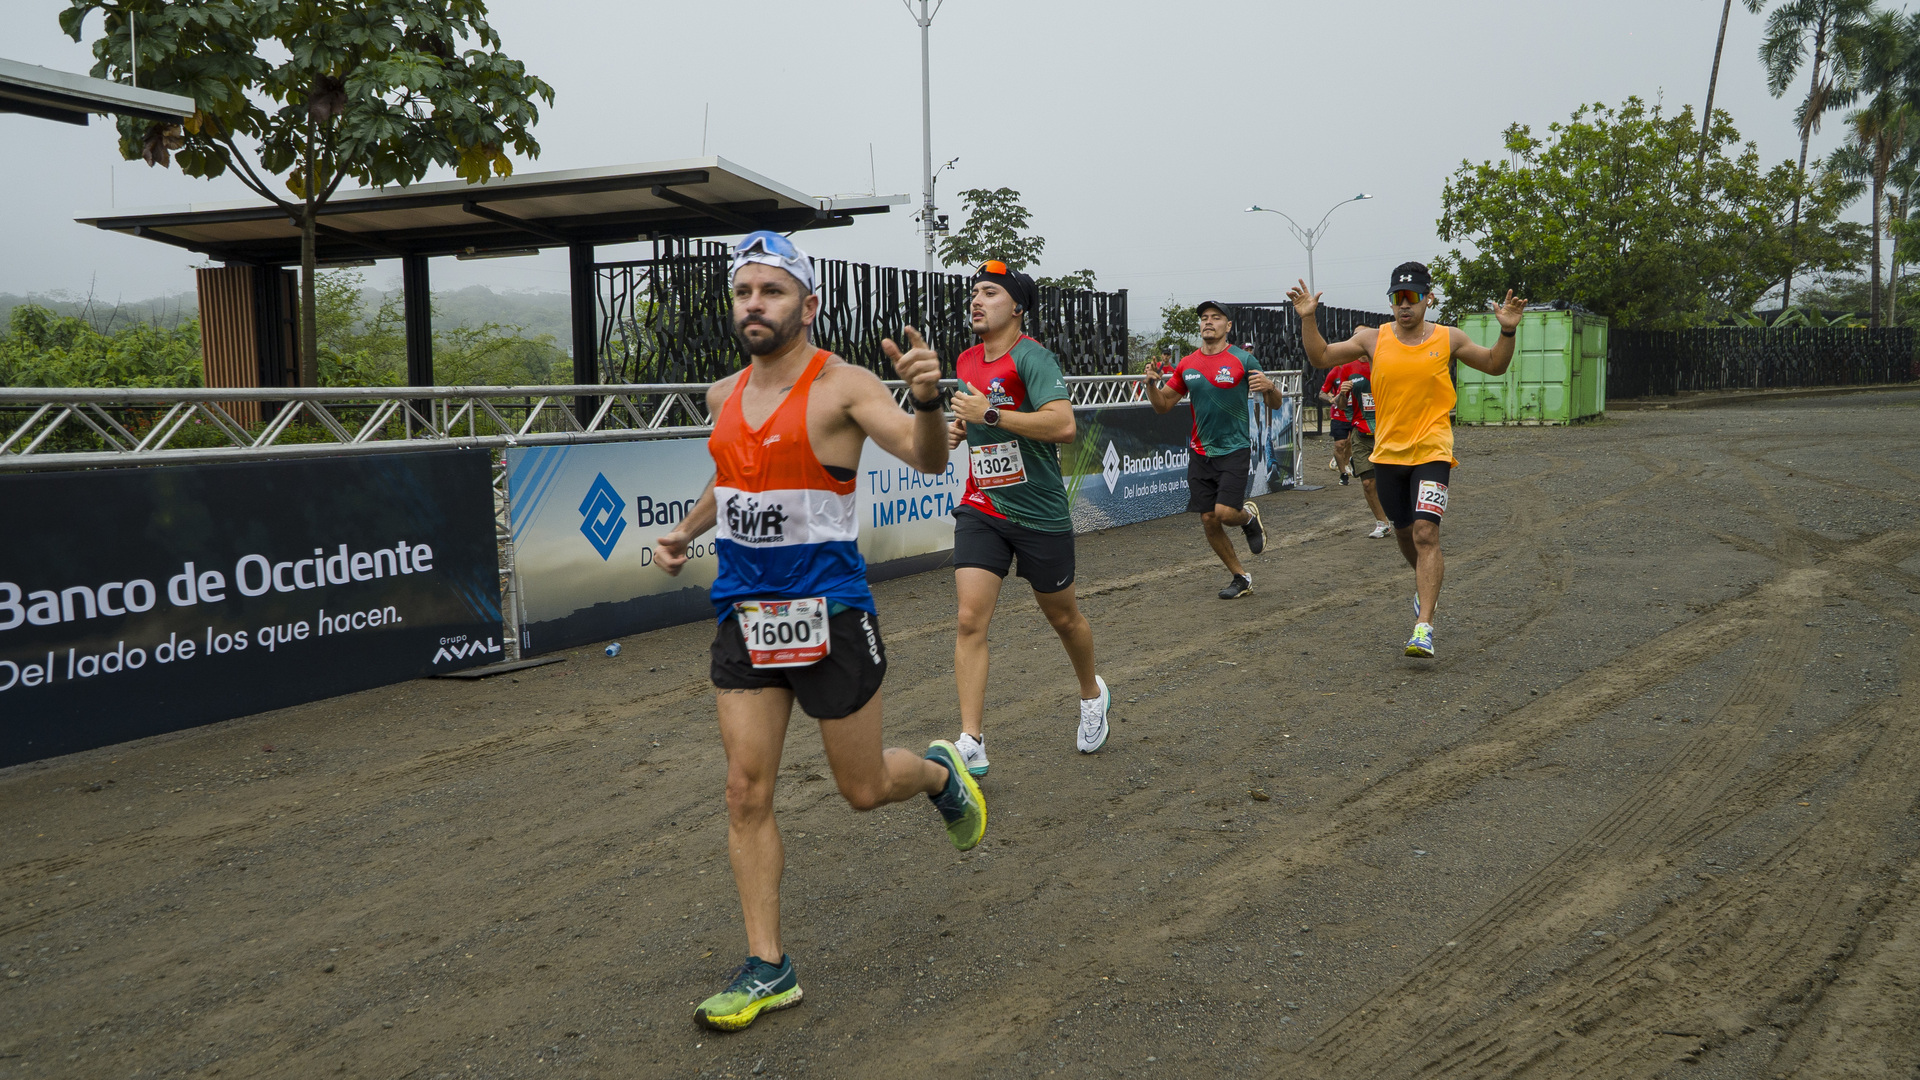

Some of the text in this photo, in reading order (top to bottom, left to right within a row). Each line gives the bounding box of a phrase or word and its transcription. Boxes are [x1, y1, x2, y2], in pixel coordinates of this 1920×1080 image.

[977, 457, 1012, 475] 1302
[1123, 448, 1190, 475] Banco de Occid
[868, 470, 891, 495] TU
[1124, 484, 1135, 499] Del
[1150, 481, 1157, 494] de
[1159, 480, 1168, 492] los
[1168, 481, 1180, 493] que
[637, 495, 699, 527] Banc
[727, 507, 783, 536] GWR
[873, 492, 955, 528] IMPACTA
[0, 541, 433, 631] Banco de Occidente
[439, 634, 468, 646] Grupo
[751, 620, 810, 645] 1600
[0, 606, 403, 691] Del lado de los que hacen.
[432, 637, 500, 664] AVAL
